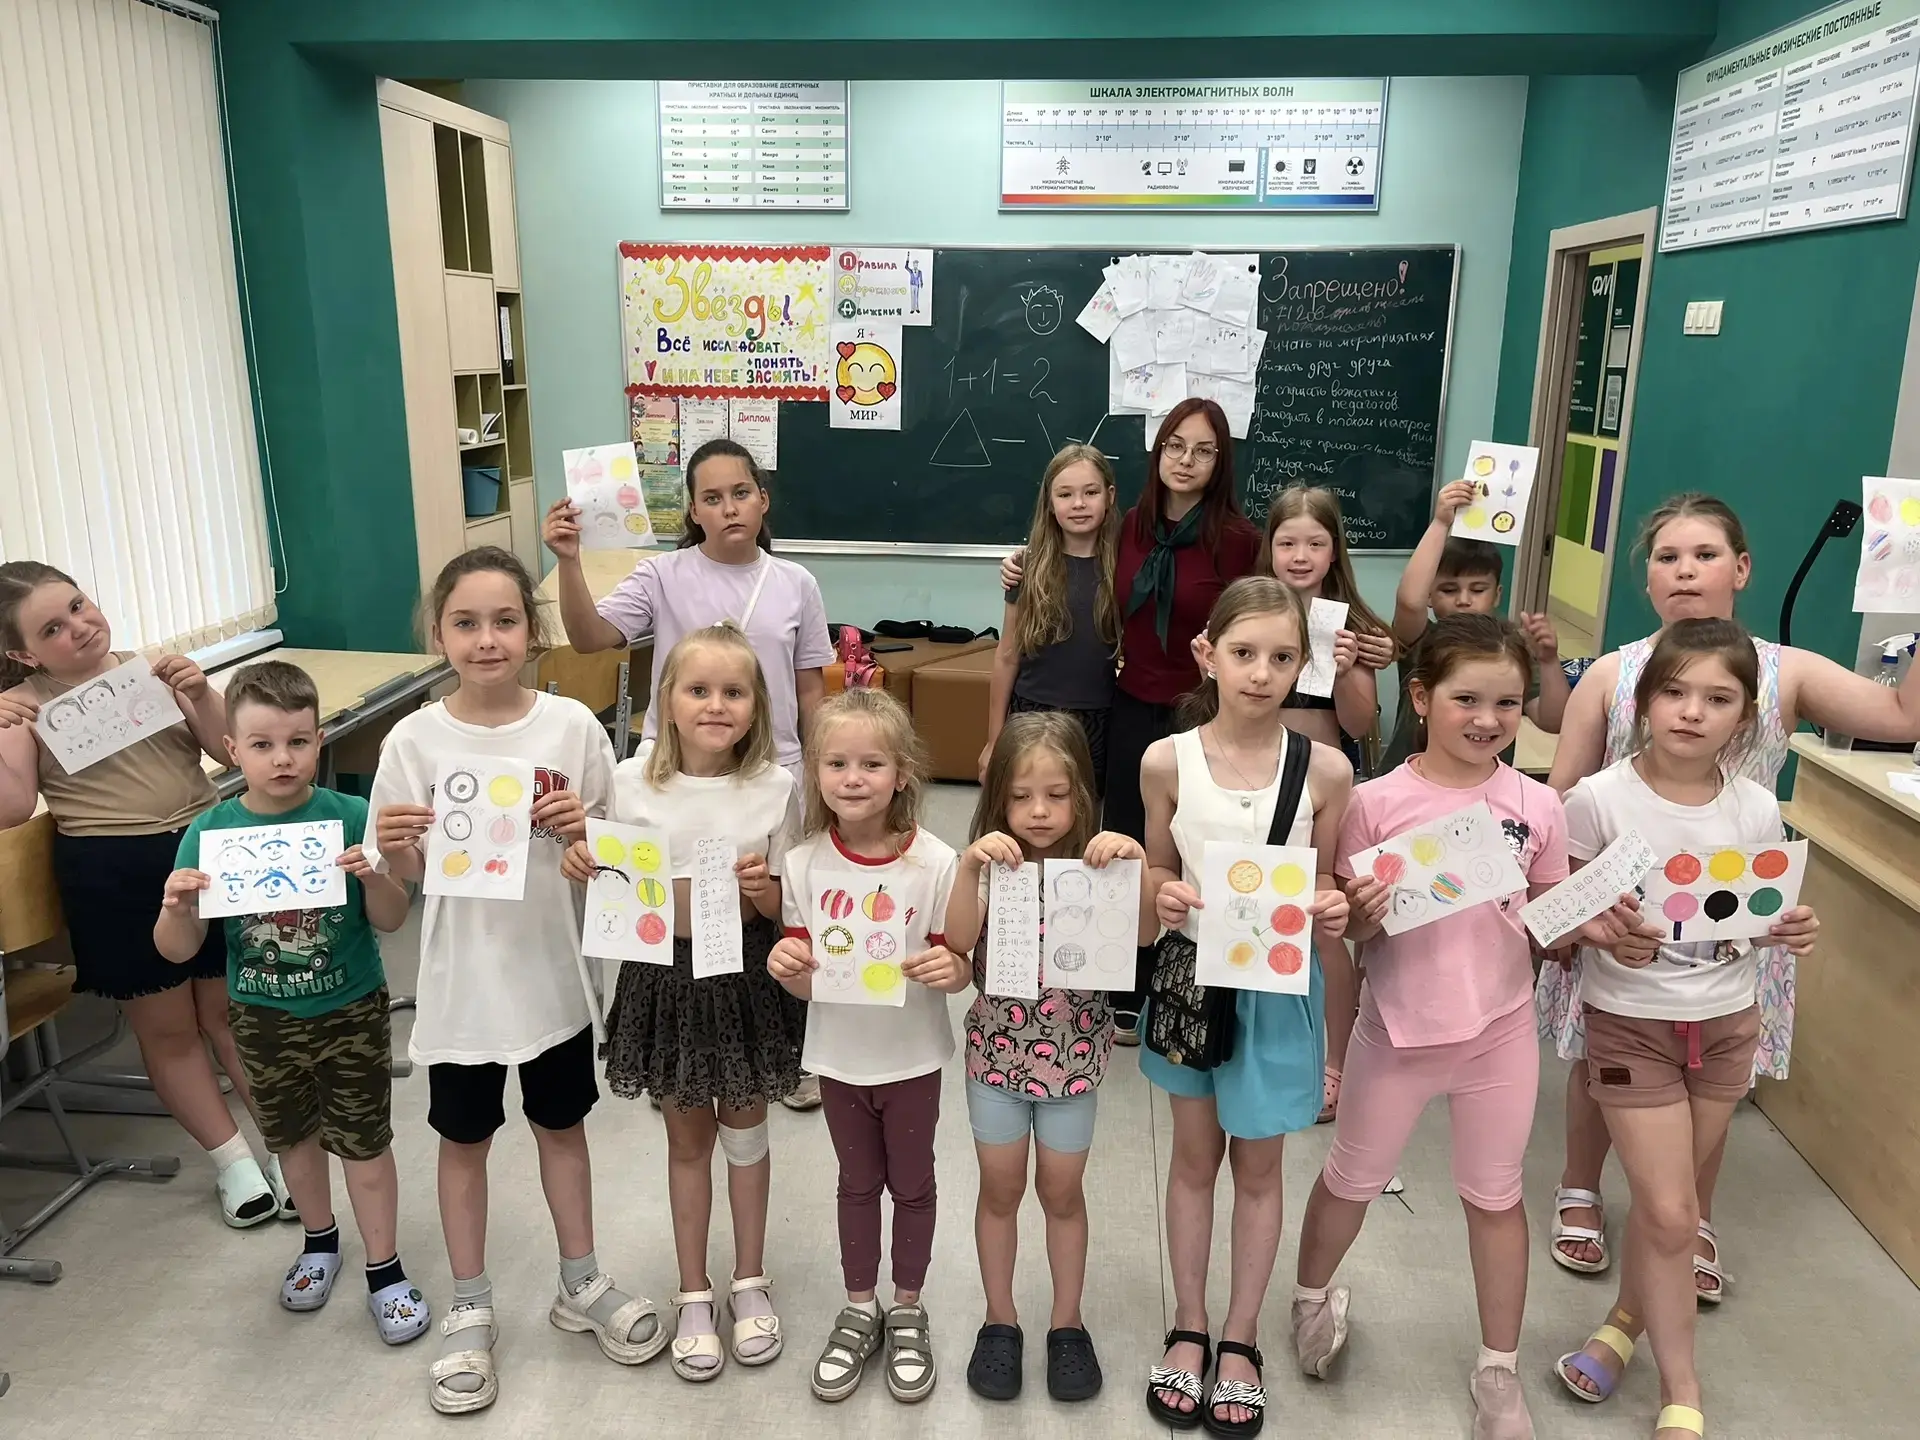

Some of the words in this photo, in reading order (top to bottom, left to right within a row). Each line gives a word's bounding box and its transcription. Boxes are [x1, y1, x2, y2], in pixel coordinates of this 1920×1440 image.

[1706, 48, 1770, 83] ФУНДАМЕНТАЛЬНЫЕ
[1772, 26, 1822, 56] ФИЗИЧЕСКИЕ
[1823, 1, 1882, 37] ПОСТОЯННЫЕ
[1090, 88, 1132, 97] ШКАЛА
[1136, 87, 1259, 97] ЭЛЕКТРОМАГНИТНЫХ
[1263, 87, 1294, 96] ВОЛН
[1262, 256, 1409, 320] Запрещено!
[657, 327, 691, 353] Всё
[857, 328, 864, 338] Я
[1263, 336, 1312, 358] ричать
[1318, 338, 1333, 348] на
[754, 357, 804, 369] ПОНЯТЬ
[1308, 360, 1342, 379] друг
[1348, 357, 1392, 378] друга
[662, 368, 674, 383] И
[678, 369, 700, 383] НА
[704, 369, 739, 383] НЕБЕ
[746, 365, 818, 384] ЗАСИЯТЬ!
[737, 412, 771, 423] Диплом
[850, 410, 878, 420] МИР
[1316, 408, 1325, 425] в
[237, 969, 344, 998] ADVENTURE
[240, 966, 256, 979] FOR
[261, 973, 278, 984] THE
[287, 970, 314, 984] NEW
